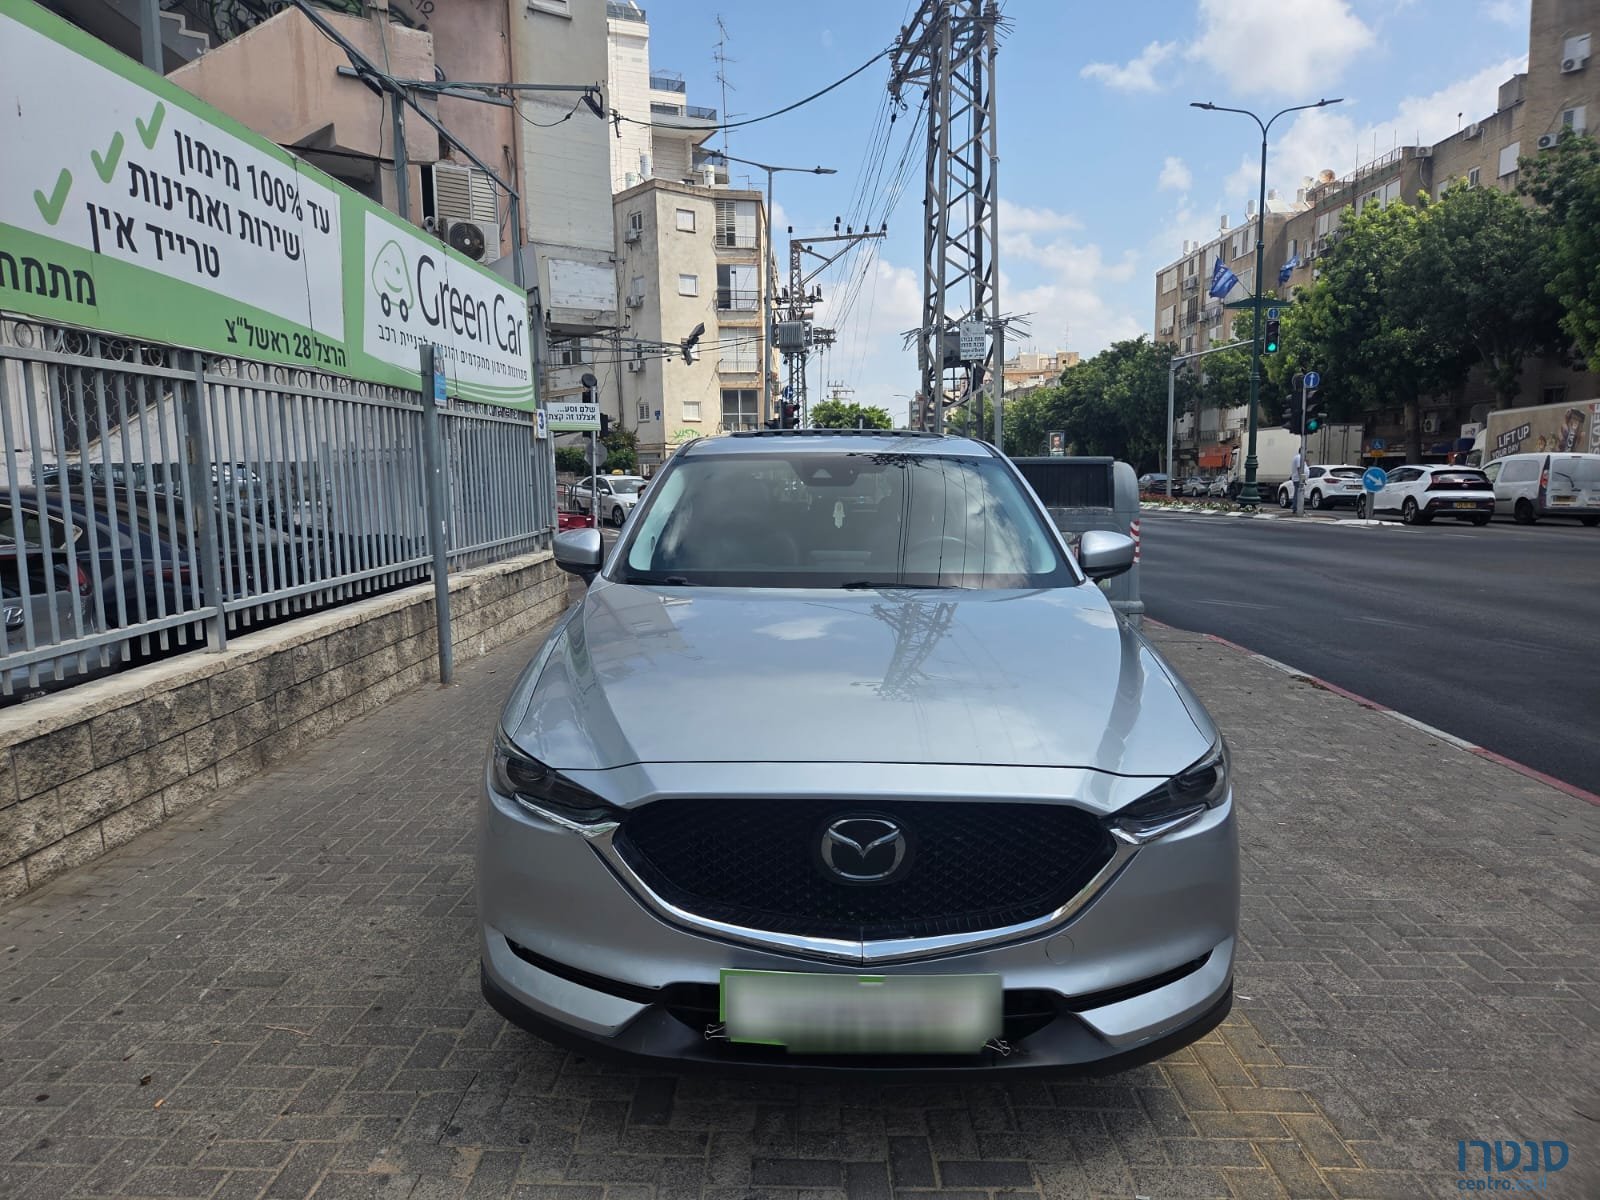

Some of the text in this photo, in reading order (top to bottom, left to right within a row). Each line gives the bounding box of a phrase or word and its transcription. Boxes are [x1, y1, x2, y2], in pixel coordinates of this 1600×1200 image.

[174, 129, 331, 234] עד 100% מימון
[128, 160, 301, 262] שירות ואמינות
[86, 202, 221, 278] טרייד אין
[417, 254, 523, 357] Green Car
[293, 332, 312, 359] 28
[378, 324, 397, 344] רכב
[314, 336, 347, 368] הרצל
[461, 350, 490, 372] מתקדמים
[576, 412, 596, 421] אצלנו
[580, 404, 596, 412] שלם
[1498, 425, 1530, 447] LIFT UP
[1507, 442, 1519, 454] DAY
